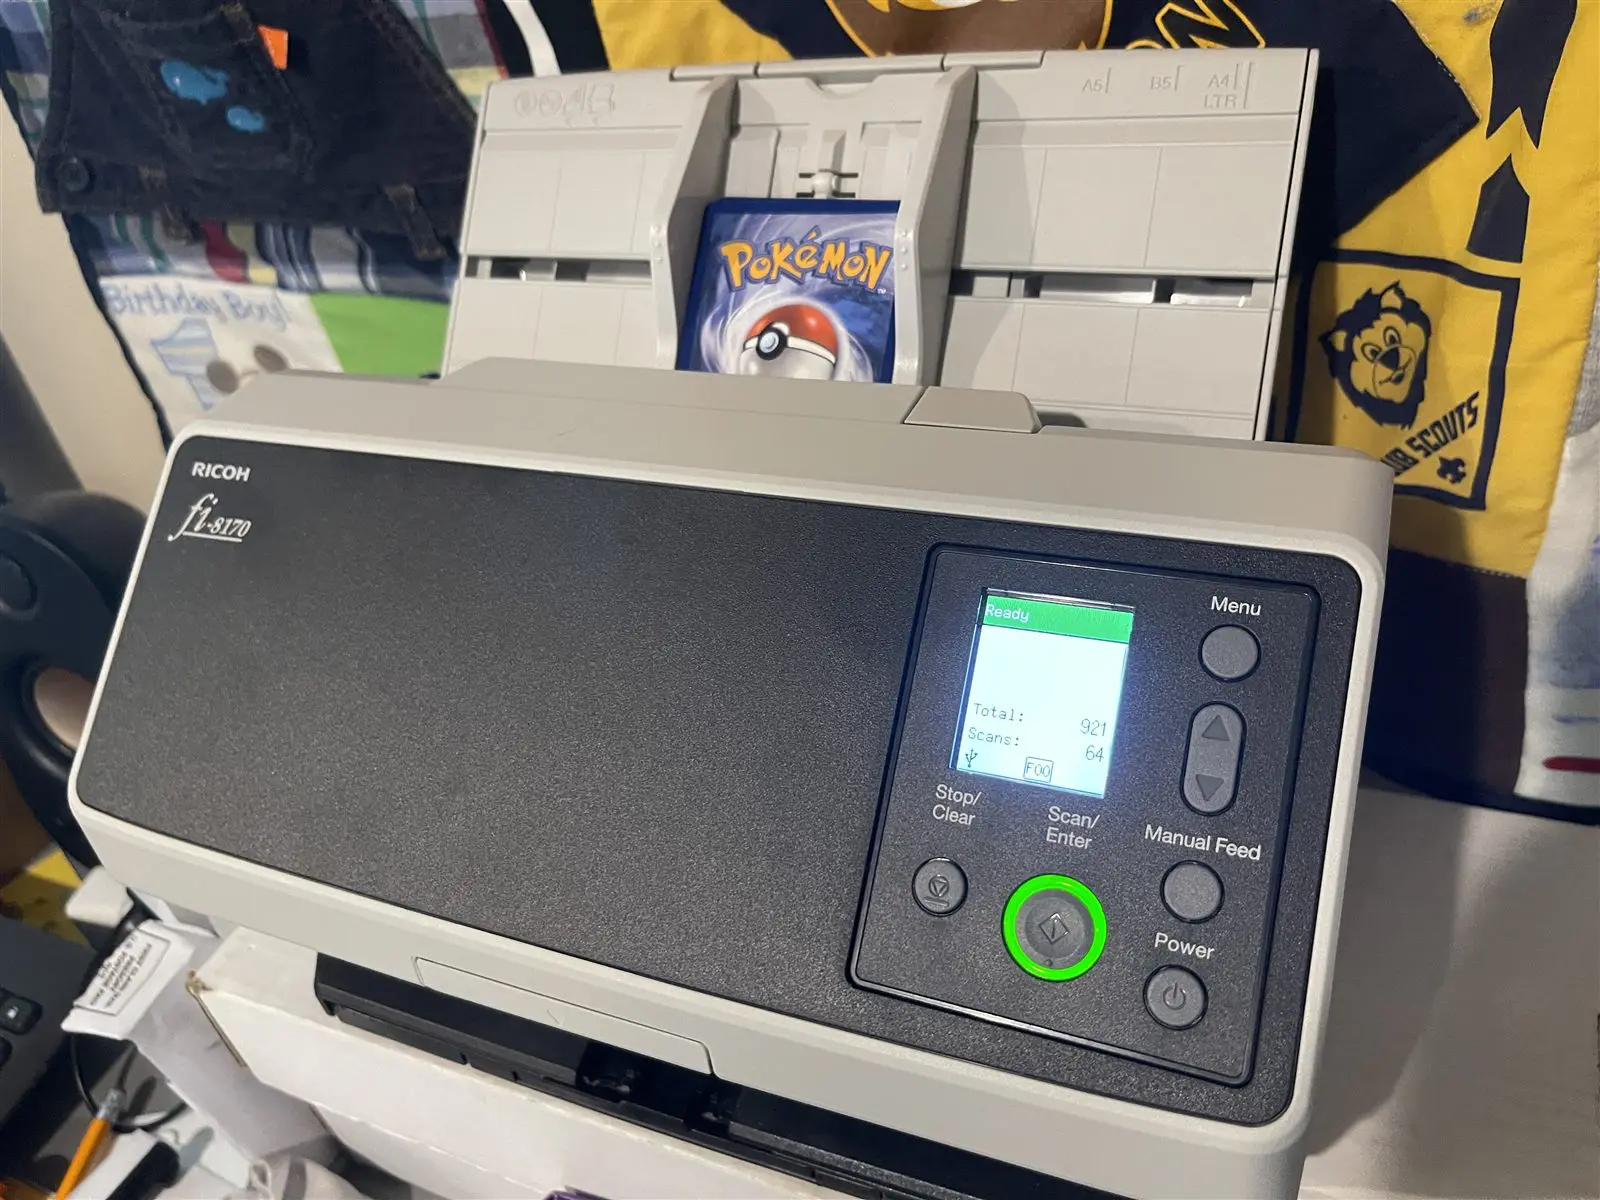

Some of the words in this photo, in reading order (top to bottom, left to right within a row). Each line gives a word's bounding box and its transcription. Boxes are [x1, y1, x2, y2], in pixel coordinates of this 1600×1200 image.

[1081, 78, 1103, 93] A5
[1150, 75, 1172, 91] B5
[1207, 73, 1230, 89] A4
[1203, 93, 1237, 109] LTR
[103, 282, 228, 323] Birthday
[1406, 391, 1480, 458] SCOUTS
[191, 461, 251, 482] RICOH
[168, 493, 251, 541] fi-8170
[984, 603, 1030, 623] Ready
[1210, 595, 1262, 616] Menu
[974, 702, 1024, 723] Total:
[1080, 718, 1107, 738] 921
[968, 726, 1020, 747] Scans:
[1085, 744, 1105, 763] 64
[935, 783, 982, 807] Stop/
[932, 804, 976, 826] Clear
[1047, 805, 1101, 829] Scan/
[1046, 827, 1093, 849] Enter
[1144, 824, 1211, 851] Manual
[1215, 837, 1262, 860] Feed
[1154, 932, 1215, 960] Power
